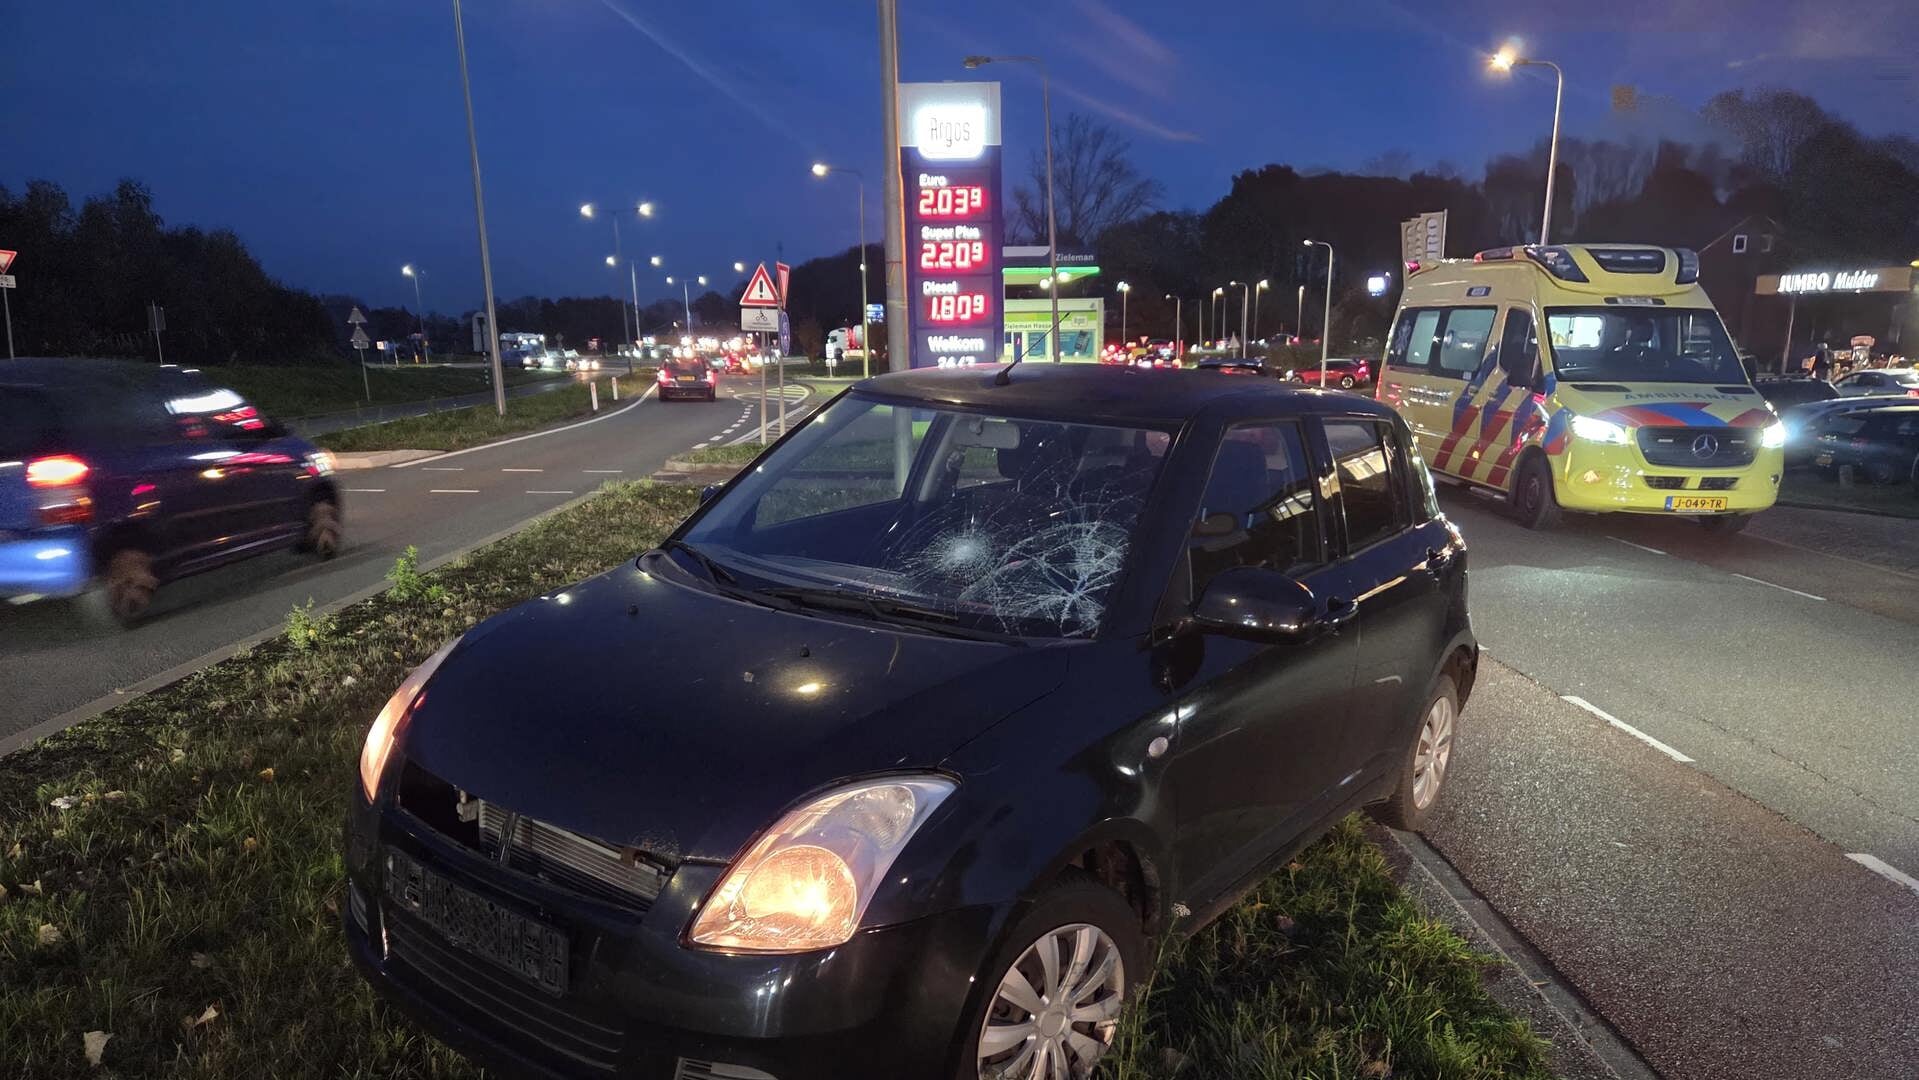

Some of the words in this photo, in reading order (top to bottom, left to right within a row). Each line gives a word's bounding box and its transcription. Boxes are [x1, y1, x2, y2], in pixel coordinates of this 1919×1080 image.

[930, 117, 970, 148] Argos
[919, 173, 947, 188] Euro
[921, 226, 954, 242] Super
[955, 225, 980, 240] Plus
[1055, 253, 1094, 262] Zieleman
[923, 280, 958, 295] Diesel
[1777, 273, 1830, 293] JUMBO
[1833, 270, 1878, 290] Mulder
[927, 335, 985, 353] Welkom
[1624, 392, 1744, 402] AMBULANCE
[1674, 498, 1723, 509] J-049-TR
